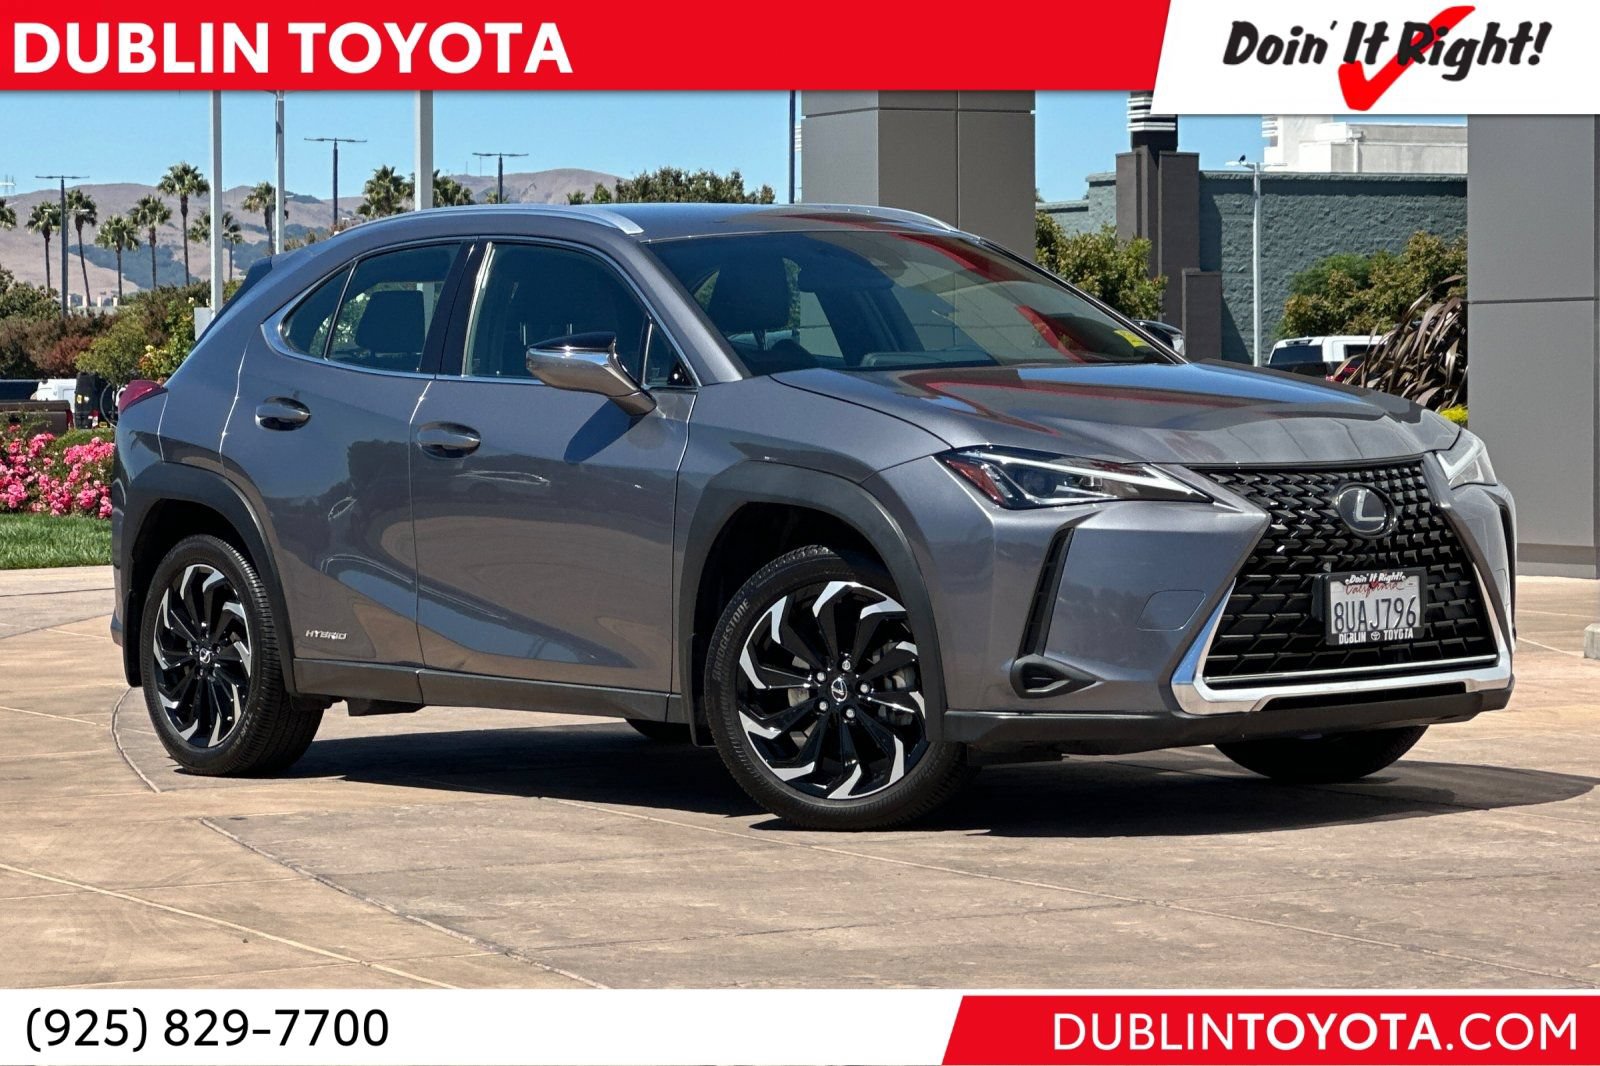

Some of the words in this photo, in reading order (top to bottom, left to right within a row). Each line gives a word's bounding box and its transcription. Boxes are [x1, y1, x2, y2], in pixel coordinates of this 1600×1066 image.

[1348, 572, 1369, 584] Doin'
[1369, 572, 1378, 583] It
[1378, 571, 1403, 583] Right!
[1334, 596, 1417, 632] 8UAJ796
[305, 629, 348, 640] HYBRID
[711, 597, 751, 682] BRIDGESTONE
[1338, 631, 1367, 645] DUBLIN
[1383, 627, 1414, 641] TOYOTA
